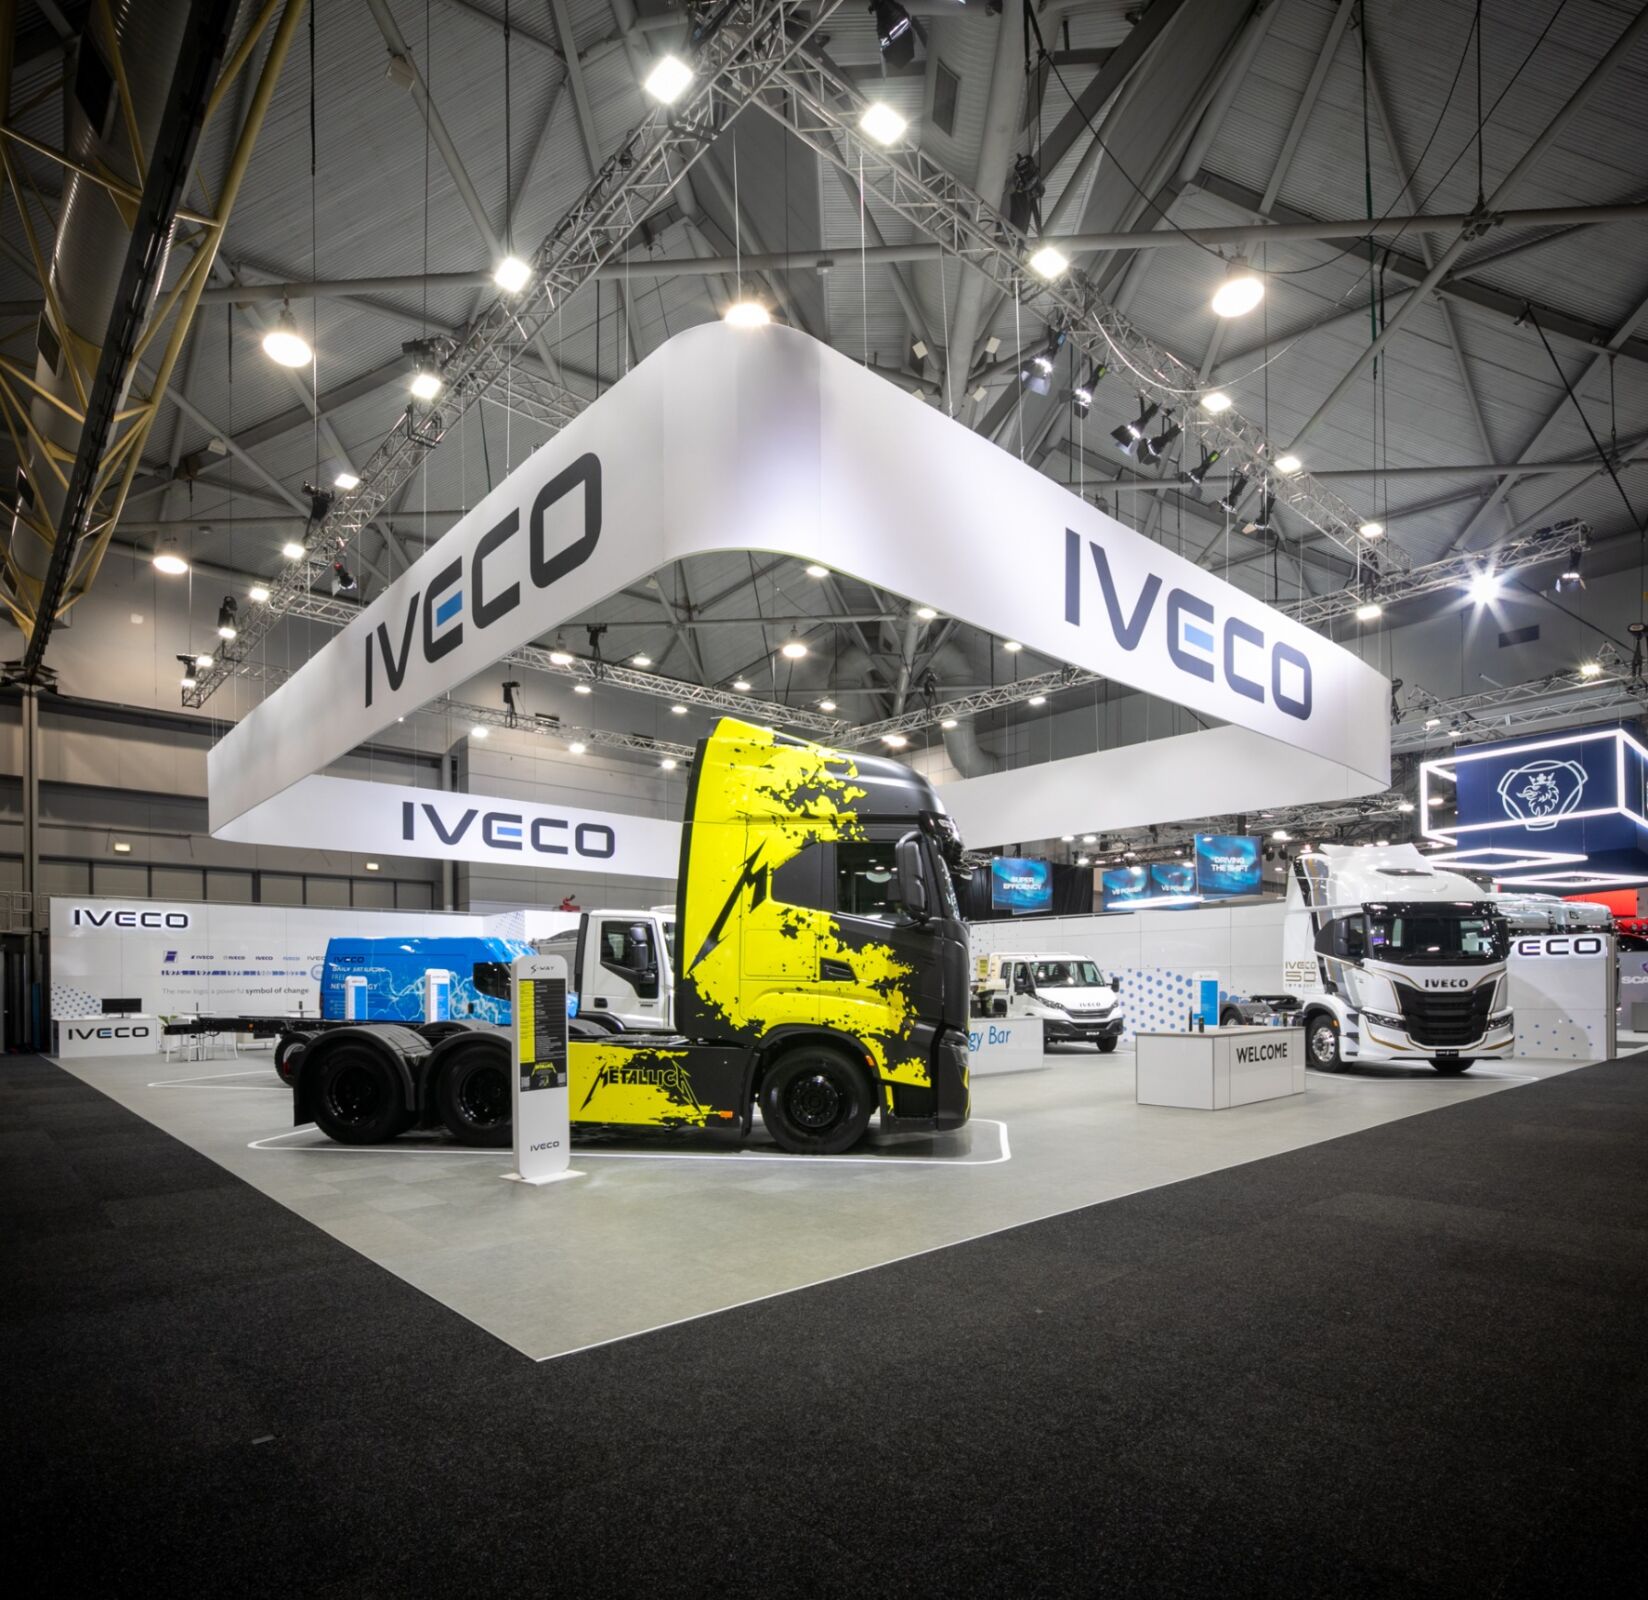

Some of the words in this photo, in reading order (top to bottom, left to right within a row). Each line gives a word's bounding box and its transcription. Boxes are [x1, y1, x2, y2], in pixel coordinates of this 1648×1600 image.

[365, 452, 602, 709] IVECO
[1065, 527, 1312, 721] IVECO
[402, 801, 615, 859] IVECO
[1214, 856, 1245, 864] DRIVING
[1211, 863, 1227, 872] THE
[1227, 864, 1249, 873] SHIFT
[1010, 876, 1035, 884] SUPER
[74, 909, 189, 929] IVECO
[1507, 938, 1602, 956] ECO
[333, 956, 365, 964] IVECO
[1285, 960, 1317, 970] IVECO
[1425, 978, 1469, 988] IVECO
[245, 987, 273, 996] symbol
[283, 987, 310, 996] change
[68, 1026, 149, 1040] IVECO
[968, 1030, 983, 1052] gy
[988, 1025, 1012, 1045] Bar
[1236, 1042, 1288, 1064] WELCOME
[579, 1060, 703, 1114] METALLICA
[530, 1140, 560, 1152] IVECO
